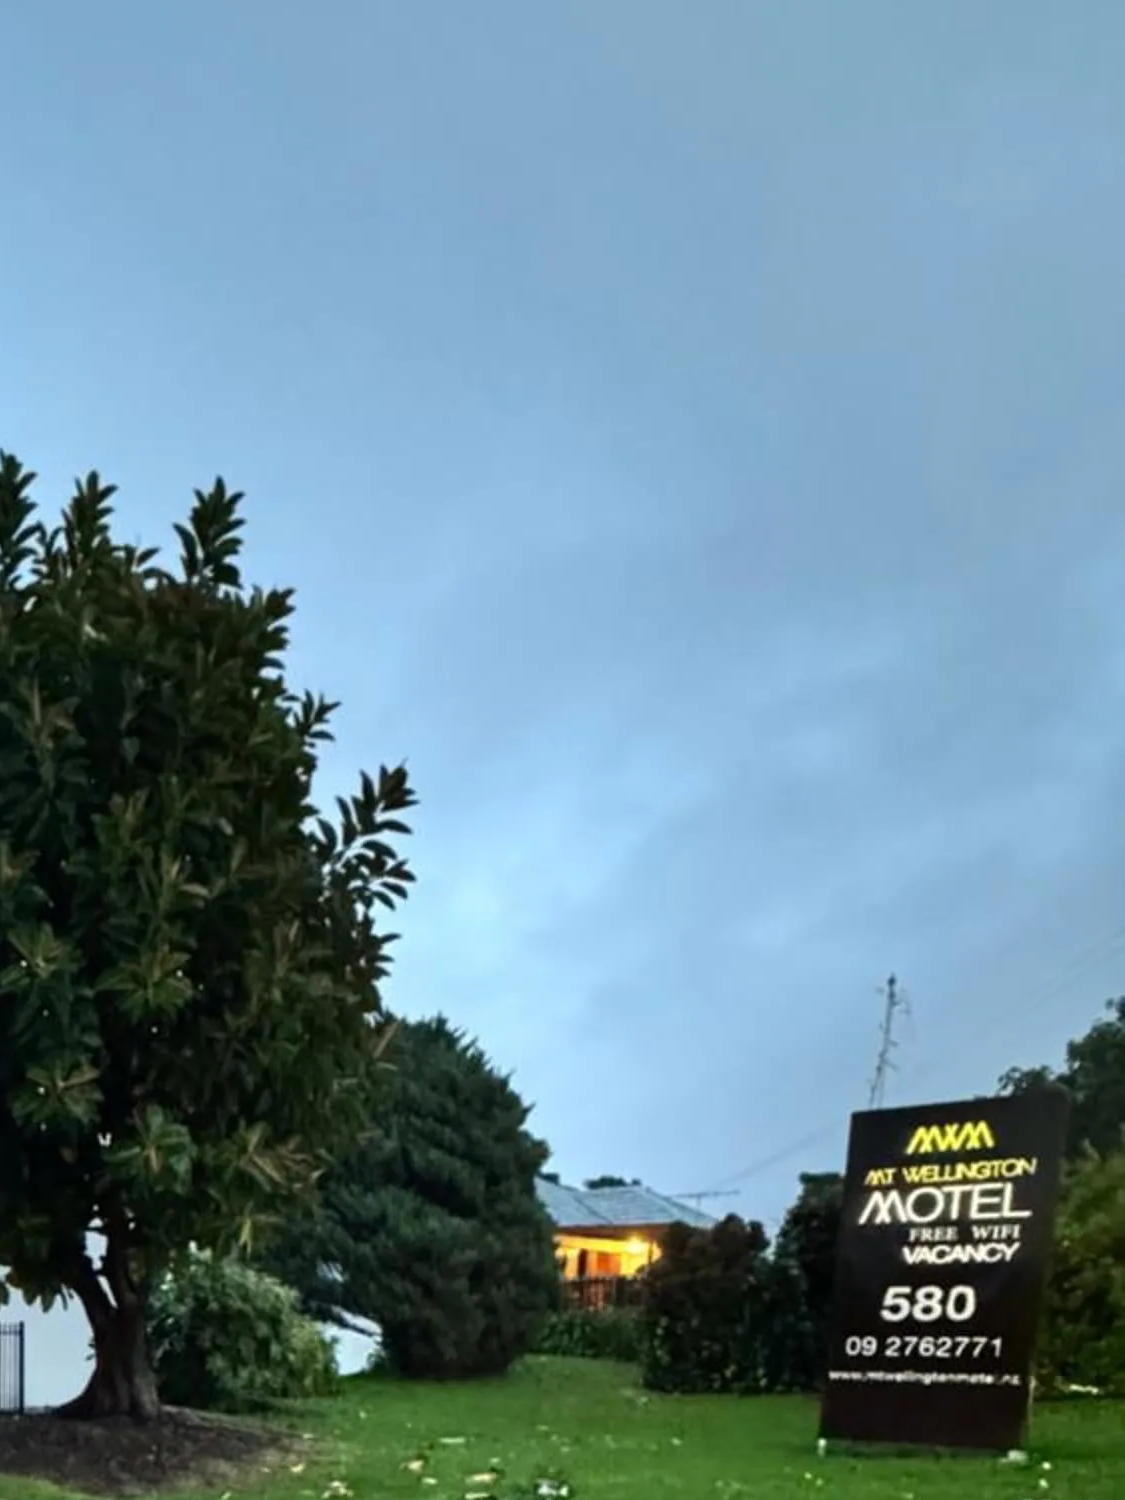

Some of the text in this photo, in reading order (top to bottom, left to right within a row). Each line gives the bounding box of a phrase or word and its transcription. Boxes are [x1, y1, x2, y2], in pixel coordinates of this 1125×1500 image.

[863, 1156, 1038, 1186] MT WELLINGTON
[857, 1181, 1033, 1226] MOTEL
[908, 1223, 1021, 1243] FREE WIFI
[901, 1241, 1021, 1266] VACANCY
[880, 1284, 977, 1323] 580
[845, 1335, 1003, 1358] 09 2762771
